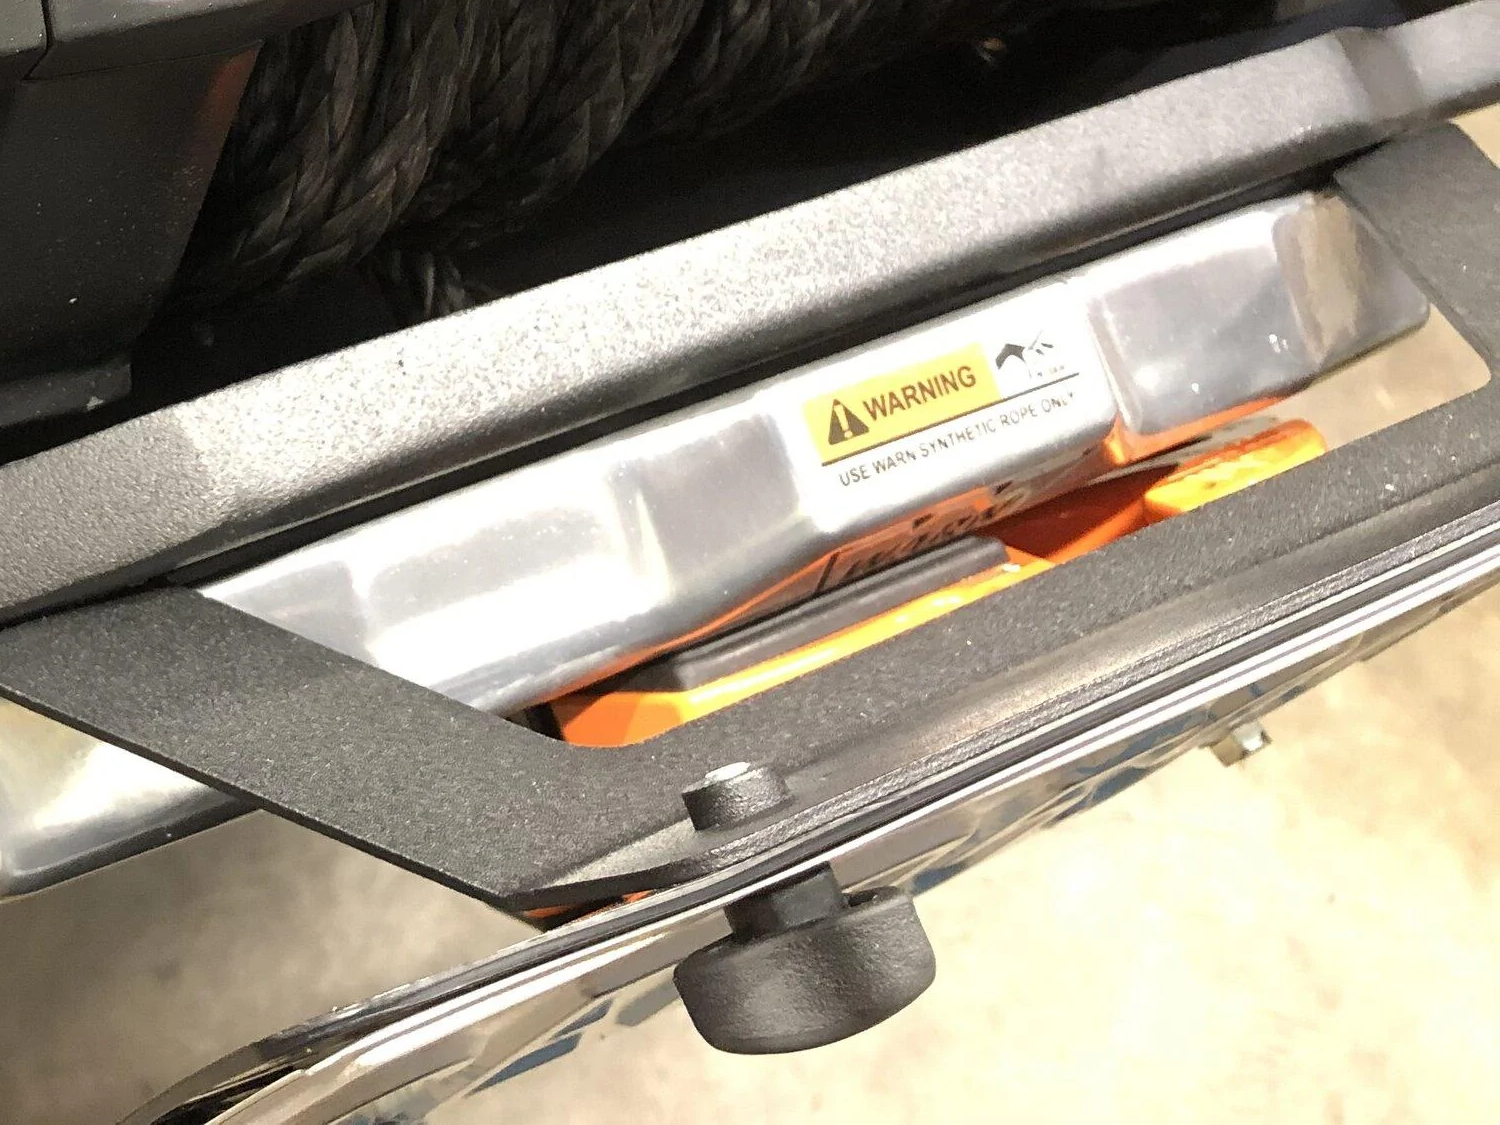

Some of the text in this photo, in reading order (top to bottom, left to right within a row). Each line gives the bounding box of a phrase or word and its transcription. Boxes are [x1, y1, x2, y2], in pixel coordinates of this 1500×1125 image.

[862, 365, 977, 422] WARNING
[839, 390, 1076, 487] USE WARN SYNTHETIC ROPE ONLY
